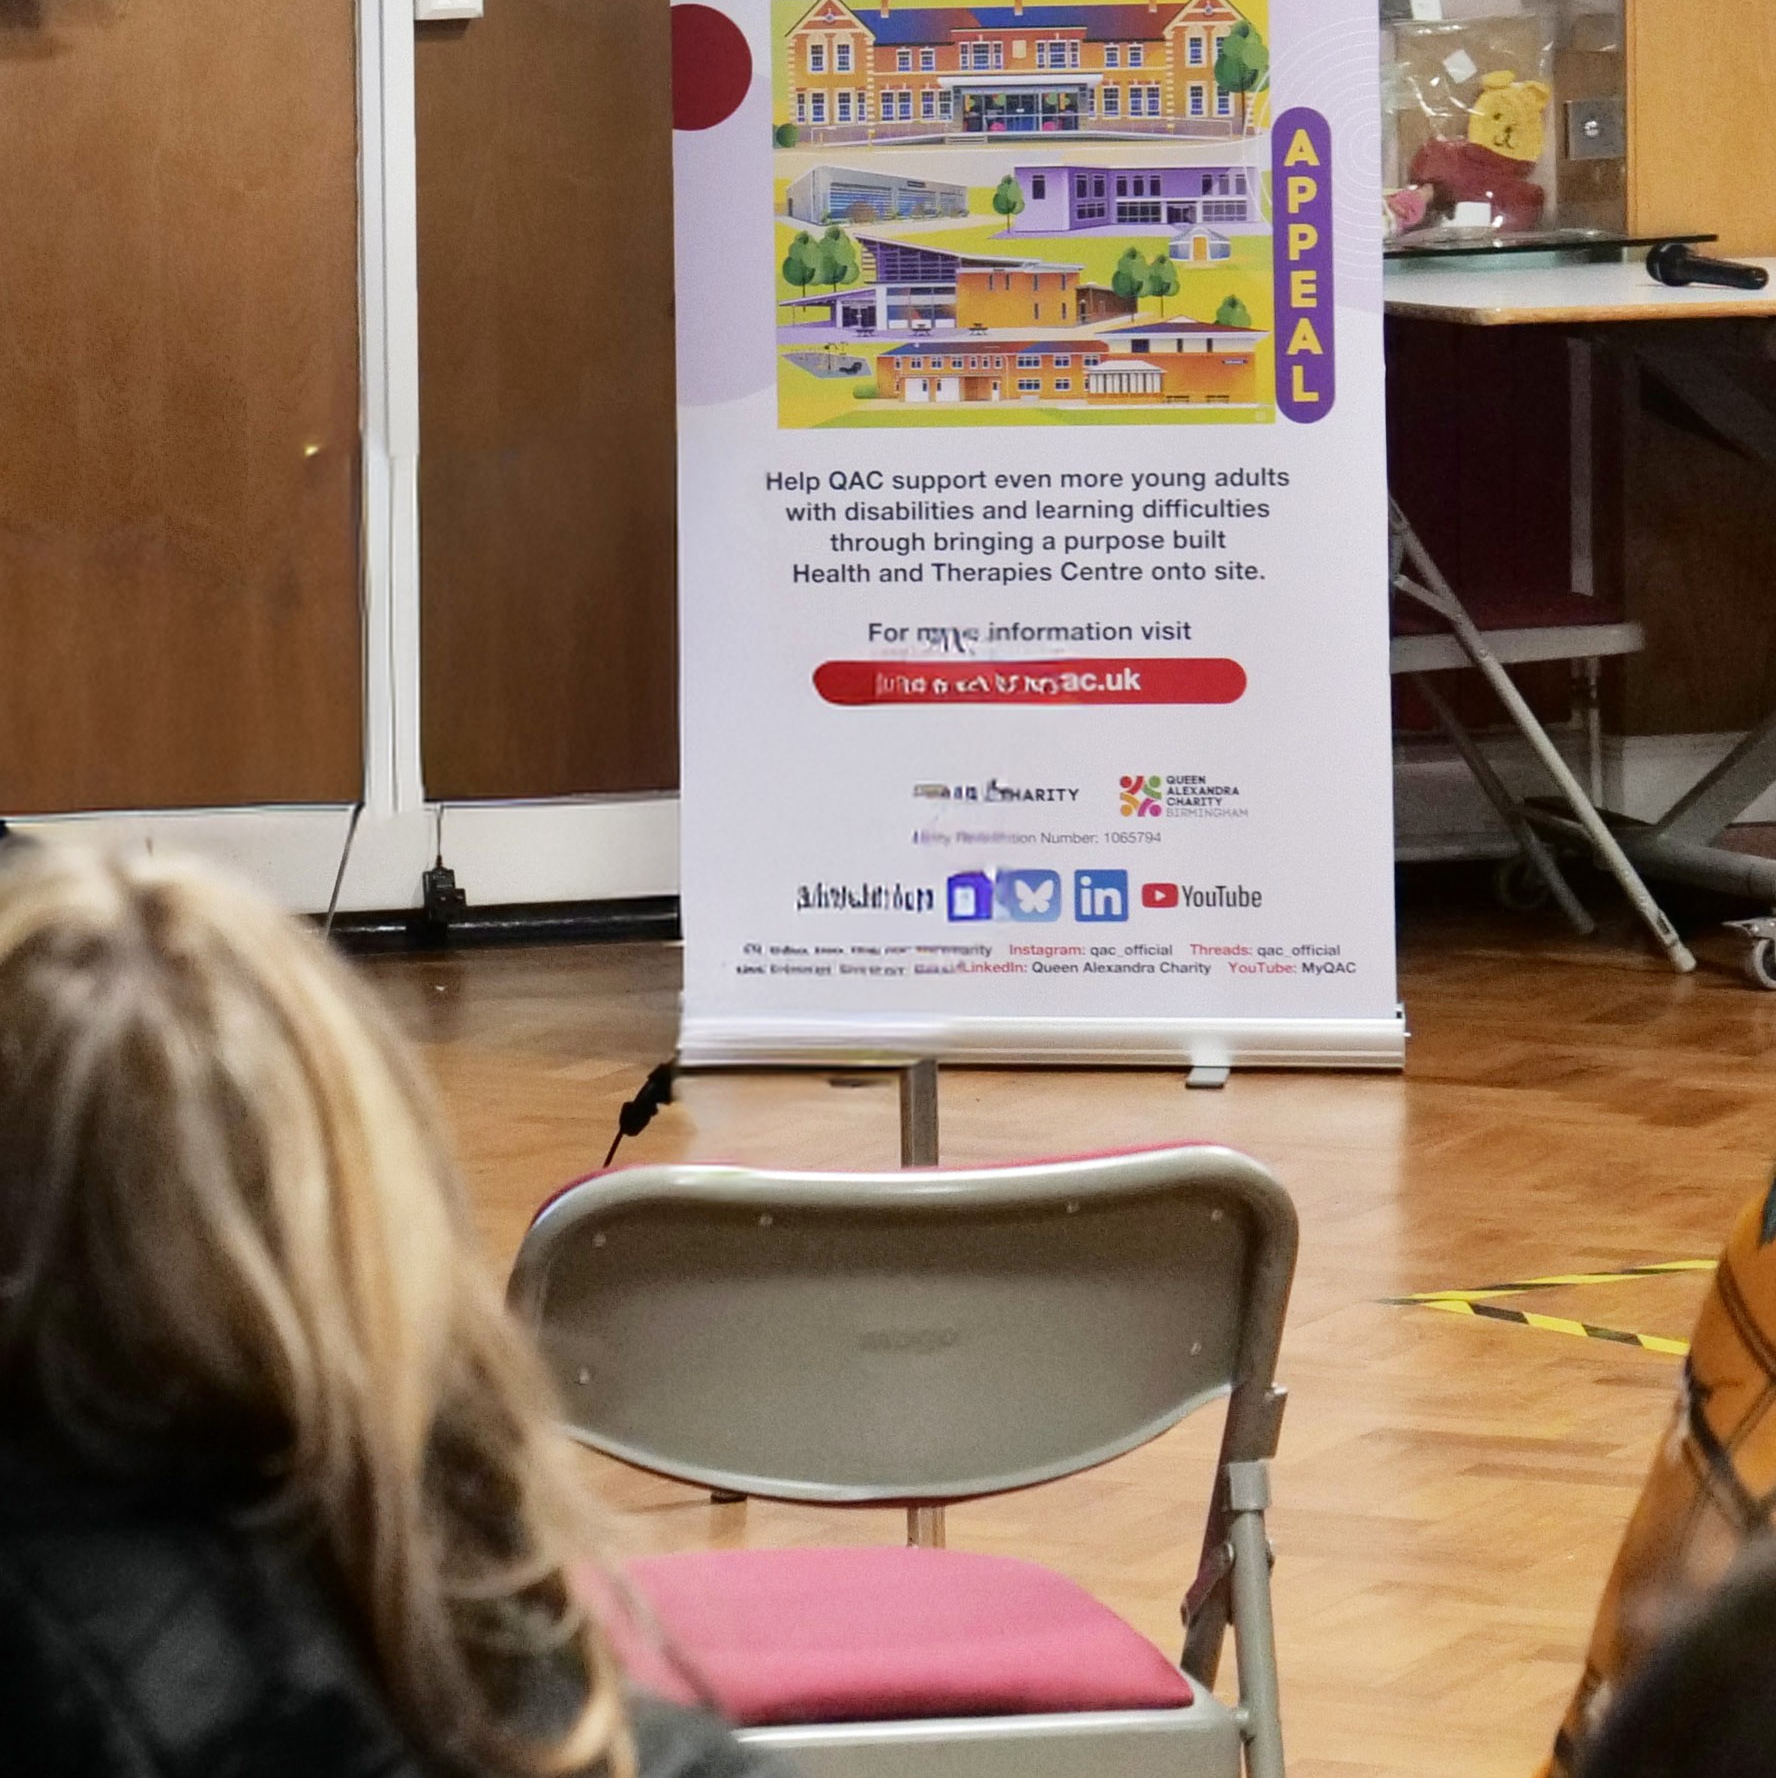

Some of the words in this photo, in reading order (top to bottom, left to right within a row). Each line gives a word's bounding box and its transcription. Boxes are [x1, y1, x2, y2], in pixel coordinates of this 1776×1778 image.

[1283, 128, 1325, 403] APPEAL
[766, 471, 821, 495] Help
[828, 470, 884, 491] QAC
[892, 470, 987, 494] support
[994, 473, 1052, 489] even
[1060, 472, 1124, 488] more
[1131, 472, 1206, 492] young
[1214, 467, 1290, 487] adults
[785, 502, 836, 522] with
[844, 500, 975, 522] disabilities
[982, 500, 1027, 520] and
[1036, 499, 1134, 524] learning
[1142, 498, 1270, 519] difficulties
[829, 532, 926, 557] through
[934, 531, 1034, 556] bringing
[1042, 535, 1056, 551] a
[1064, 534, 1165, 555] purpose
[1173, 529, 1227, 550] built
[793, 563, 871, 584] Health
[879, 562, 923, 583] and
[930, 562, 1053, 586] Therapies
[1060, 561, 1143, 582] Centre
[1151, 562, 1207, 581] onto
[1214, 560, 1265, 581] site.
[868, 622, 910, 643] For
[988, 621, 1133, 642] information
[1140, 620, 1192, 641] visit
[1166, 775, 1206, 785] QUEEN
[1167, 786, 1240, 796] ALEXANDRA
[1166, 796, 1222, 807] CHARITY
[1103, 831, 1162, 844] 1065794
[1181, 884, 1263, 908] YouTube
[1009, 944, 1086, 959] Instagram:
[1089, 943, 1173, 958] qac_official
[1189, 943, 1252, 956] Threads:
[1256, 944, 1341, 959] qac_official
[1031, 961, 1079, 974] Queen
[1082, 961, 1156, 974] Alexandra
[1159, 961, 1212, 976] Charity
[1227, 961, 1297, 974] YouTube:
[1301, 961, 1356, 976] MyQAC
